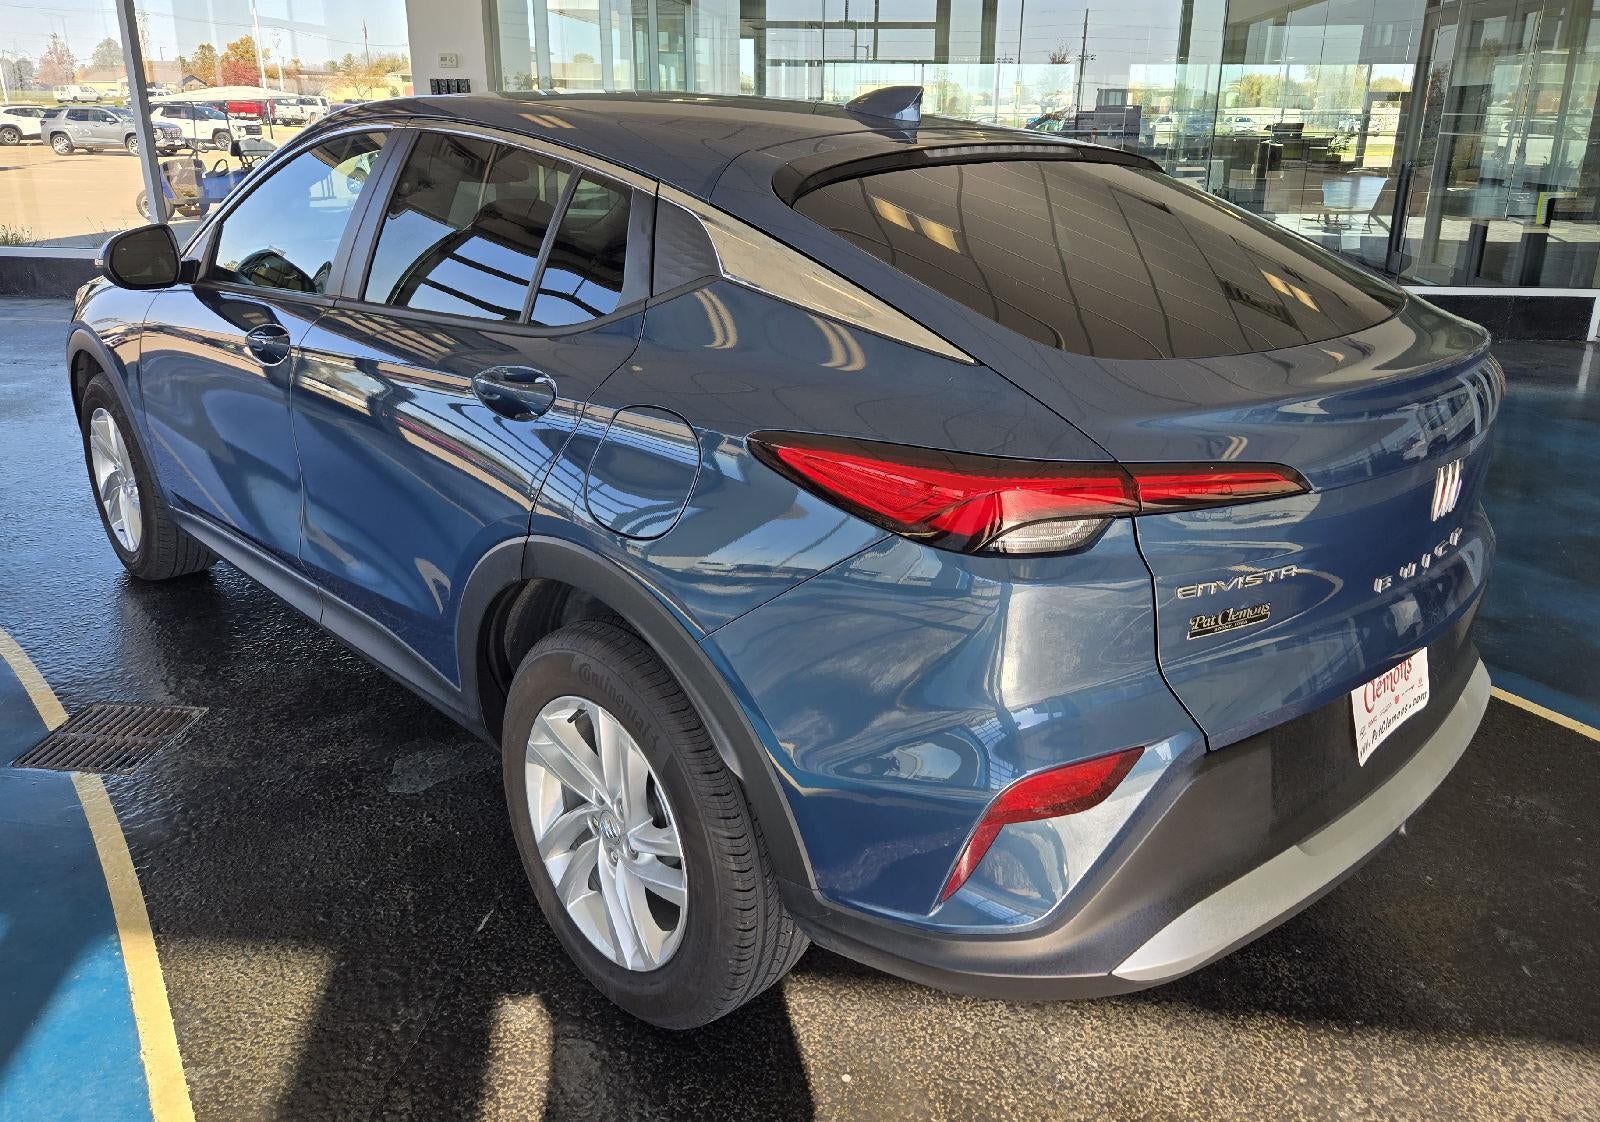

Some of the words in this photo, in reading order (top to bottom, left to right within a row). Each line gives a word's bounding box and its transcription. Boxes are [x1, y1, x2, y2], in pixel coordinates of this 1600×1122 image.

[1176, 564, 1298, 599] ENVISTA
[1373, 527, 1463, 594] BUICK
[1189, 615, 1216, 630] Pat
[1218, 602, 1270, 625] Clemons
[580, 662, 652, 736] Continental
